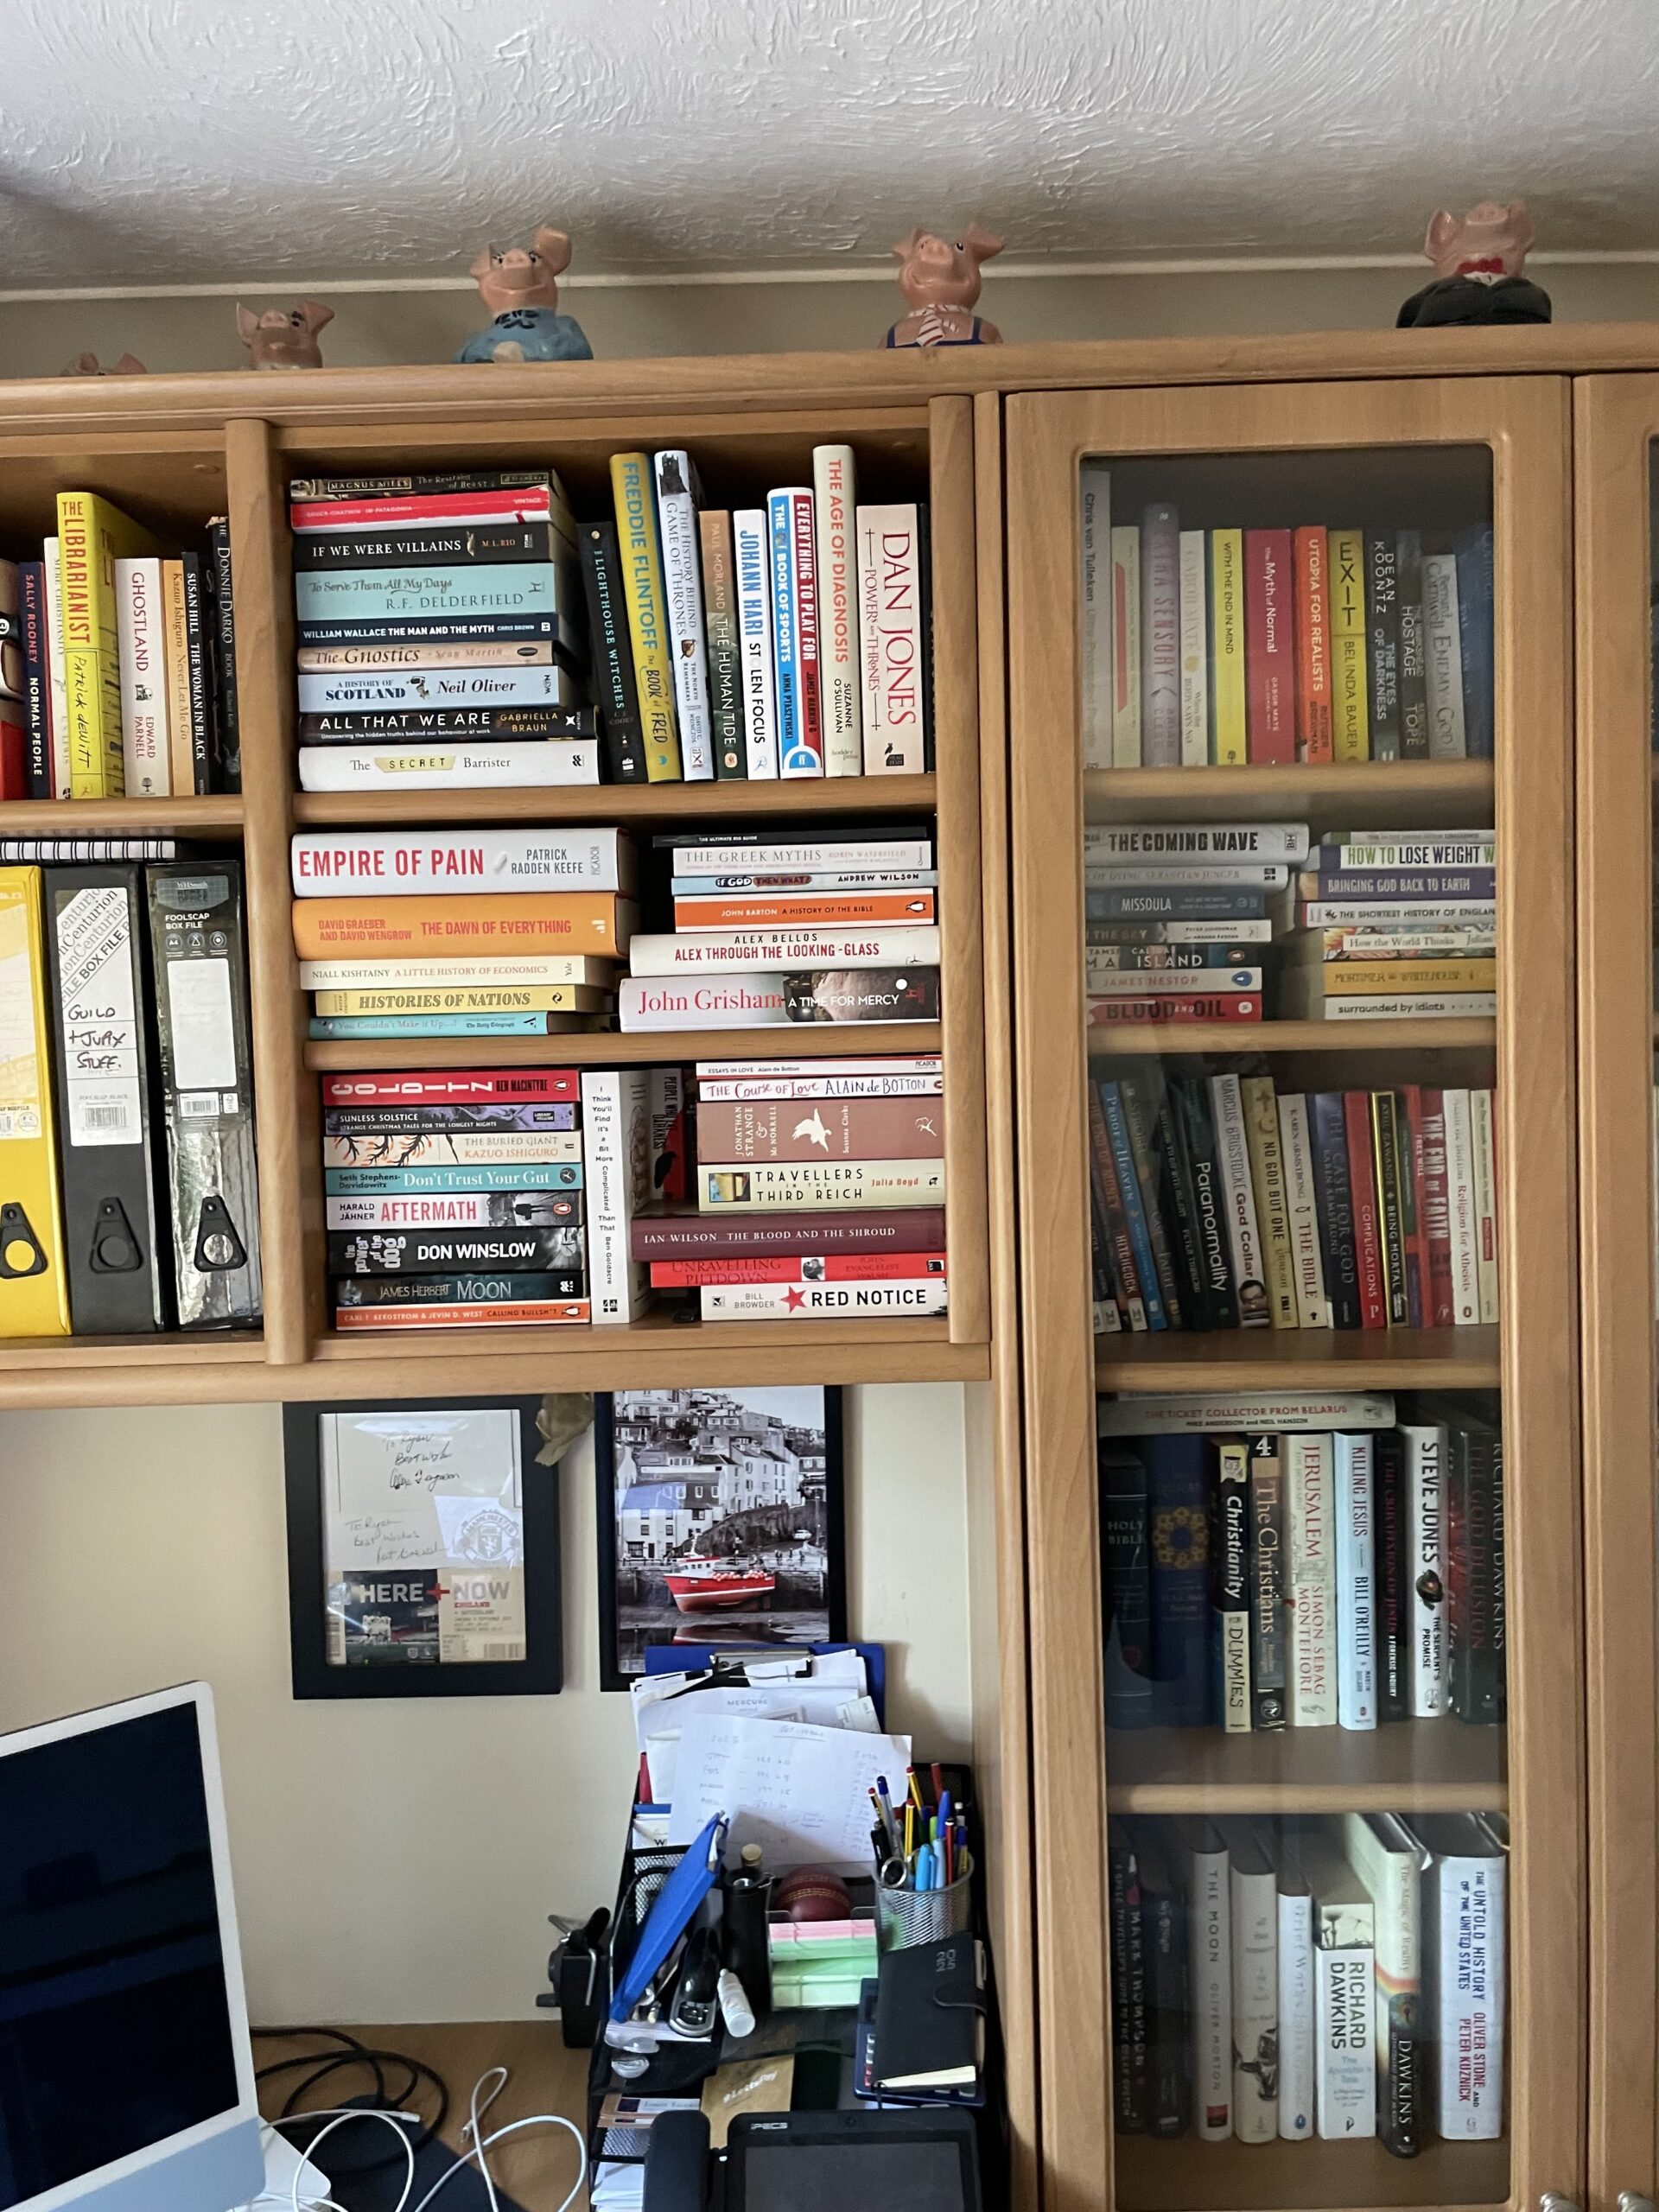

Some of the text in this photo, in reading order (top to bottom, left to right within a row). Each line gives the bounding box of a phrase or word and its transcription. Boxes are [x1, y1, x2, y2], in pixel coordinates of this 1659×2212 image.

[313, 540, 461, 556] IF WE WERE VILLAINS
[622, 461, 658, 651] FREDDIE FLINTOFF
[665, 502, 687, 636] GAME OF THRONES
[828, 460, 849, 663] THE AGE OF DIAGNOSIS
[62, 501, 90, 643] THE LIBRARIANIST
[217, 546, 232, 644] DONNIE DARKO
[740, 531, 763, 636] JOHANN HARI
[796, 502, 817, 660] EVERYTHING TO PLAY FOR
[1266, 562, 1275, 595] Myth
[1339, 542, 1355, 626] EXIT
[1375, 541, 1395, 613] DEAN KOONTZ
[25, 575, 38, 664] SALLY ROONEY
[131, 572, 149, 671] GHOSTLAND
[303, 630, 342, 639] WILLIAM
[344, 627, 386, 638] WALLACE
[388, 627, 405, 636] THE
[408, 626, 427, 635] MAN
[429, 626, 448, 634] AND
[594, 558, 625, 709] LIGHTHOUSE WITCHES
[880, 532, 916, 725] DAN JONES
[1267, 607, 1277, 653] Normal
[1309, 539, 1323, 691] UTOPIA FOR REALISTS
[187, 573, 206, 760] SUSAN HILL THE WOMAN IN BLACK
[344, 647, 420, 664] Gnostics
[326, 688, 405, 701] SCOTLAND
[437, 680, 517, 694] Neil Oliver
[716, 618, 737, 746] THE HUMAN TIDE
[1344, 641, 1357, 750] BELINDA BAUER
[29, 677, 42, 776] NORMAL PEOPLE
[321, 712, 491, 729] ALL THAT WE ARE
[752, 698, 765, 743] FOCUS
[350, 757, 511, 771] The SECRET Barrister
[299, 849, 484, 876] EMPIRE OF PAIN
[684, 849, 822, 862] THE GREEK MYTHS
[1108, 832, 1258, 851] THE COMING WAVE
[1348, 847, 1479, 864] HOW TO LOSE WEIGHT
[1122, 897, 1172, 912] MISSOULA
[1328, 877, 1471, 893] BRINGING GOD BACK TO EARTH
[421, 919, 571, 935] THE DAWN OF EVERYTHING
[734, 934, 818, 944] ALEX BELLOS
[675, 947, 782, 961] ALEX THROUGH THE
[68, 1004, 115, 1020] GUILD
[359, 993, 531, 1009] HISTORIES OF NATIONS
[638, 988, 783, 1014] John Grisham
[788, 995, 899, 1007] A TIME FOR MERCY
[1338, 1002, 1445, 1014] surrounded by idiots
[404, 1171, 550, 1186] Don't Trust Your Gut
[755, 1169, 862, 1182] TRAVELLERS
[757, 1189, 862, 1201] THIRD REICH
[381, 1201, 476, 1222] AFTERMATH
[1197, 1162, 1226, 1292] Paranormality
[418, 1243, 536, 1261] DON WINSLOW
[1236, 1193, 1254, 1277] God Collar
[1299, 1221, 1318, 1299] THE BIBLE
[457, 1281, 512, 1299] MOON
[811, 1290, 926, 1306] RED NOTICE
[1302, 1446, 1322, 1558] JERUSALEM
[1351, 1446, 1368, 1537] KILLING JESUS
[1422, 1442, 1440, 1563] STEVE JONES
[1225, 1496, 1243, 1599] Christianity
[1255, 1482, 1280, 1633] The Christians
[359, 1583, 423, 1603] HERE
[454, 1581, 509, 1600] NOW
[1354, 1576, 1370, 1656] BILL O'REILLY
[1472, 1891, 1485, 1999] UNTOLD HISTORY
[1331, 1962, 1346, 2049] DAWKINS
[1349, 1962, 1366, 2049] RICHARD
[1473, 2012, 1485, 2088] OLIVER STONE
[1398, 2040, 1413, 2125] DAWKINS
